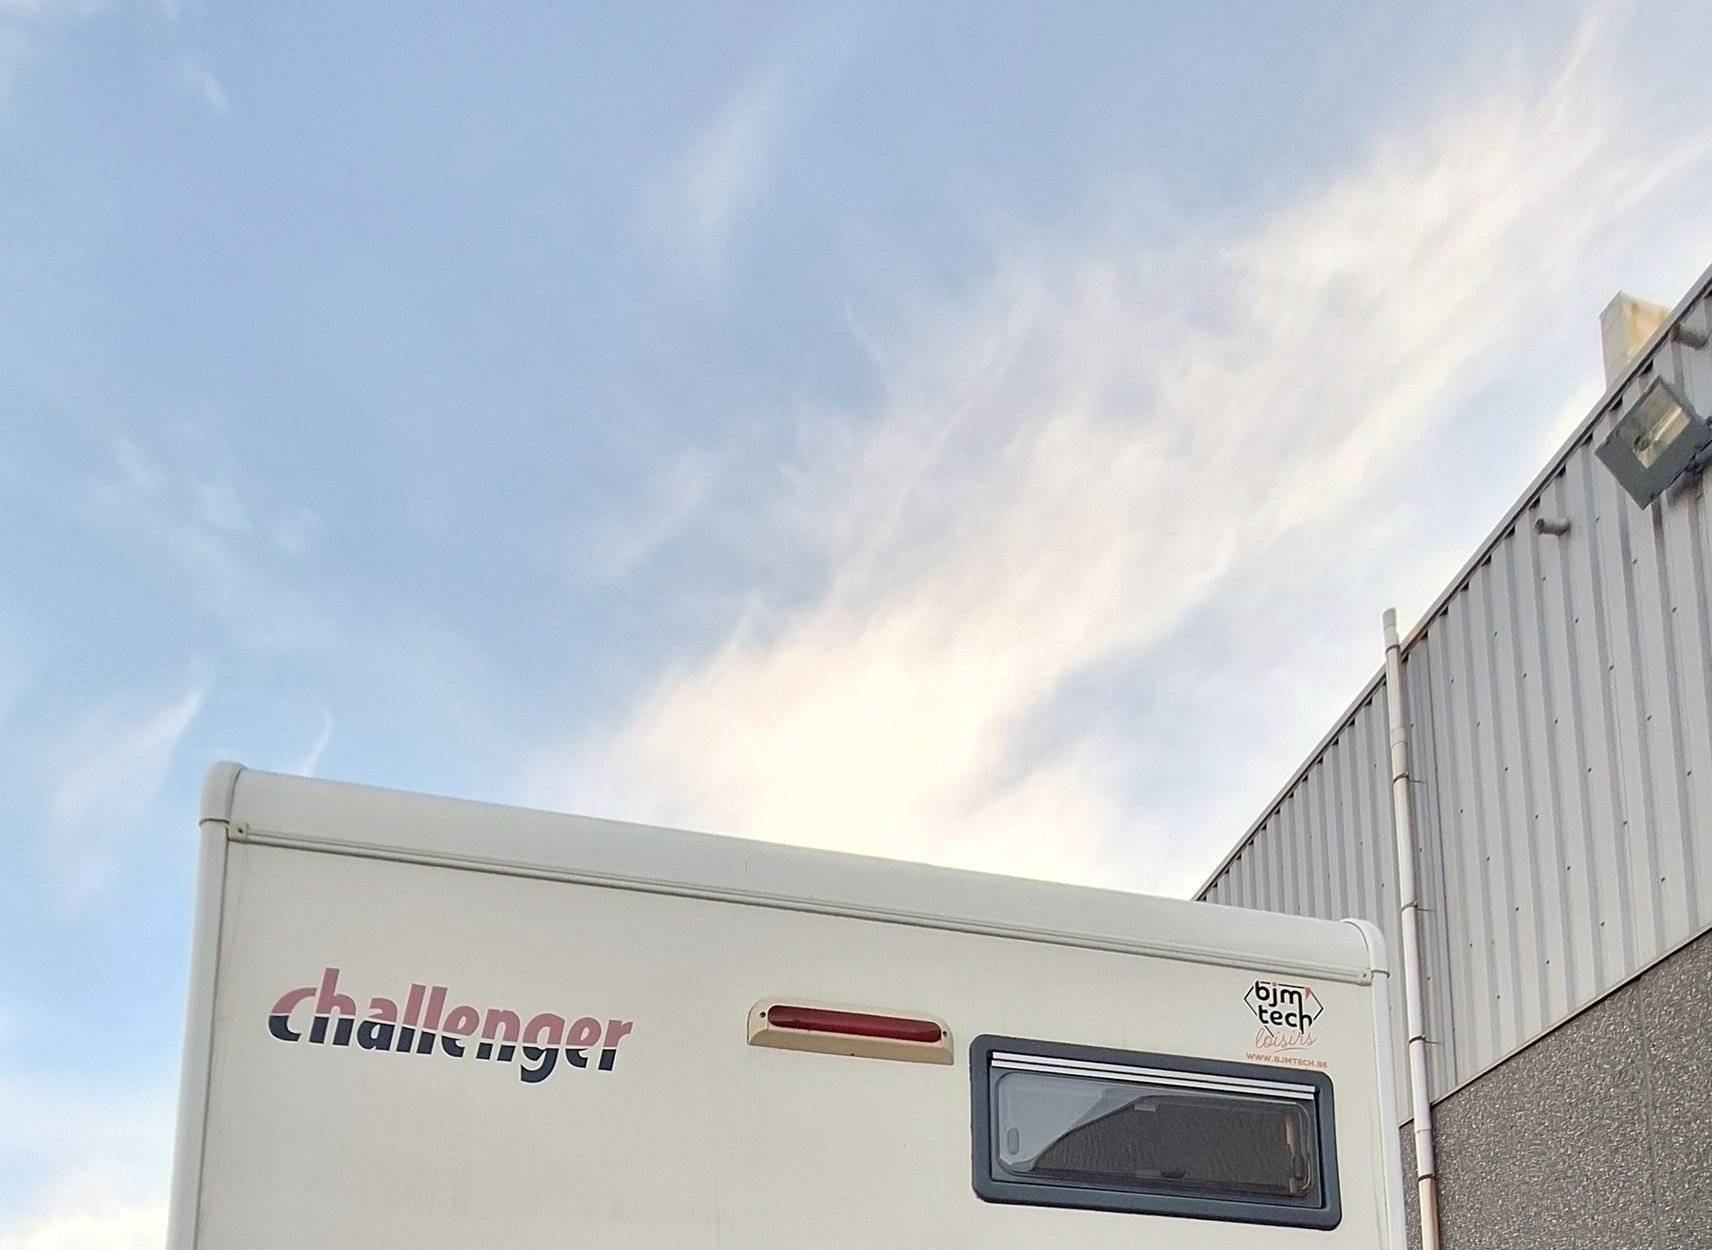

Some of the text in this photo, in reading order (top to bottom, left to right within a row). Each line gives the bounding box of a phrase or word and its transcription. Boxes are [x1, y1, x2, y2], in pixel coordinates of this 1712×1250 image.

[1255, 981, 1303, 1008] bjm
[268, 967, 634, 1083] challenger
[1258, 1004, 1313, 1035] tech
